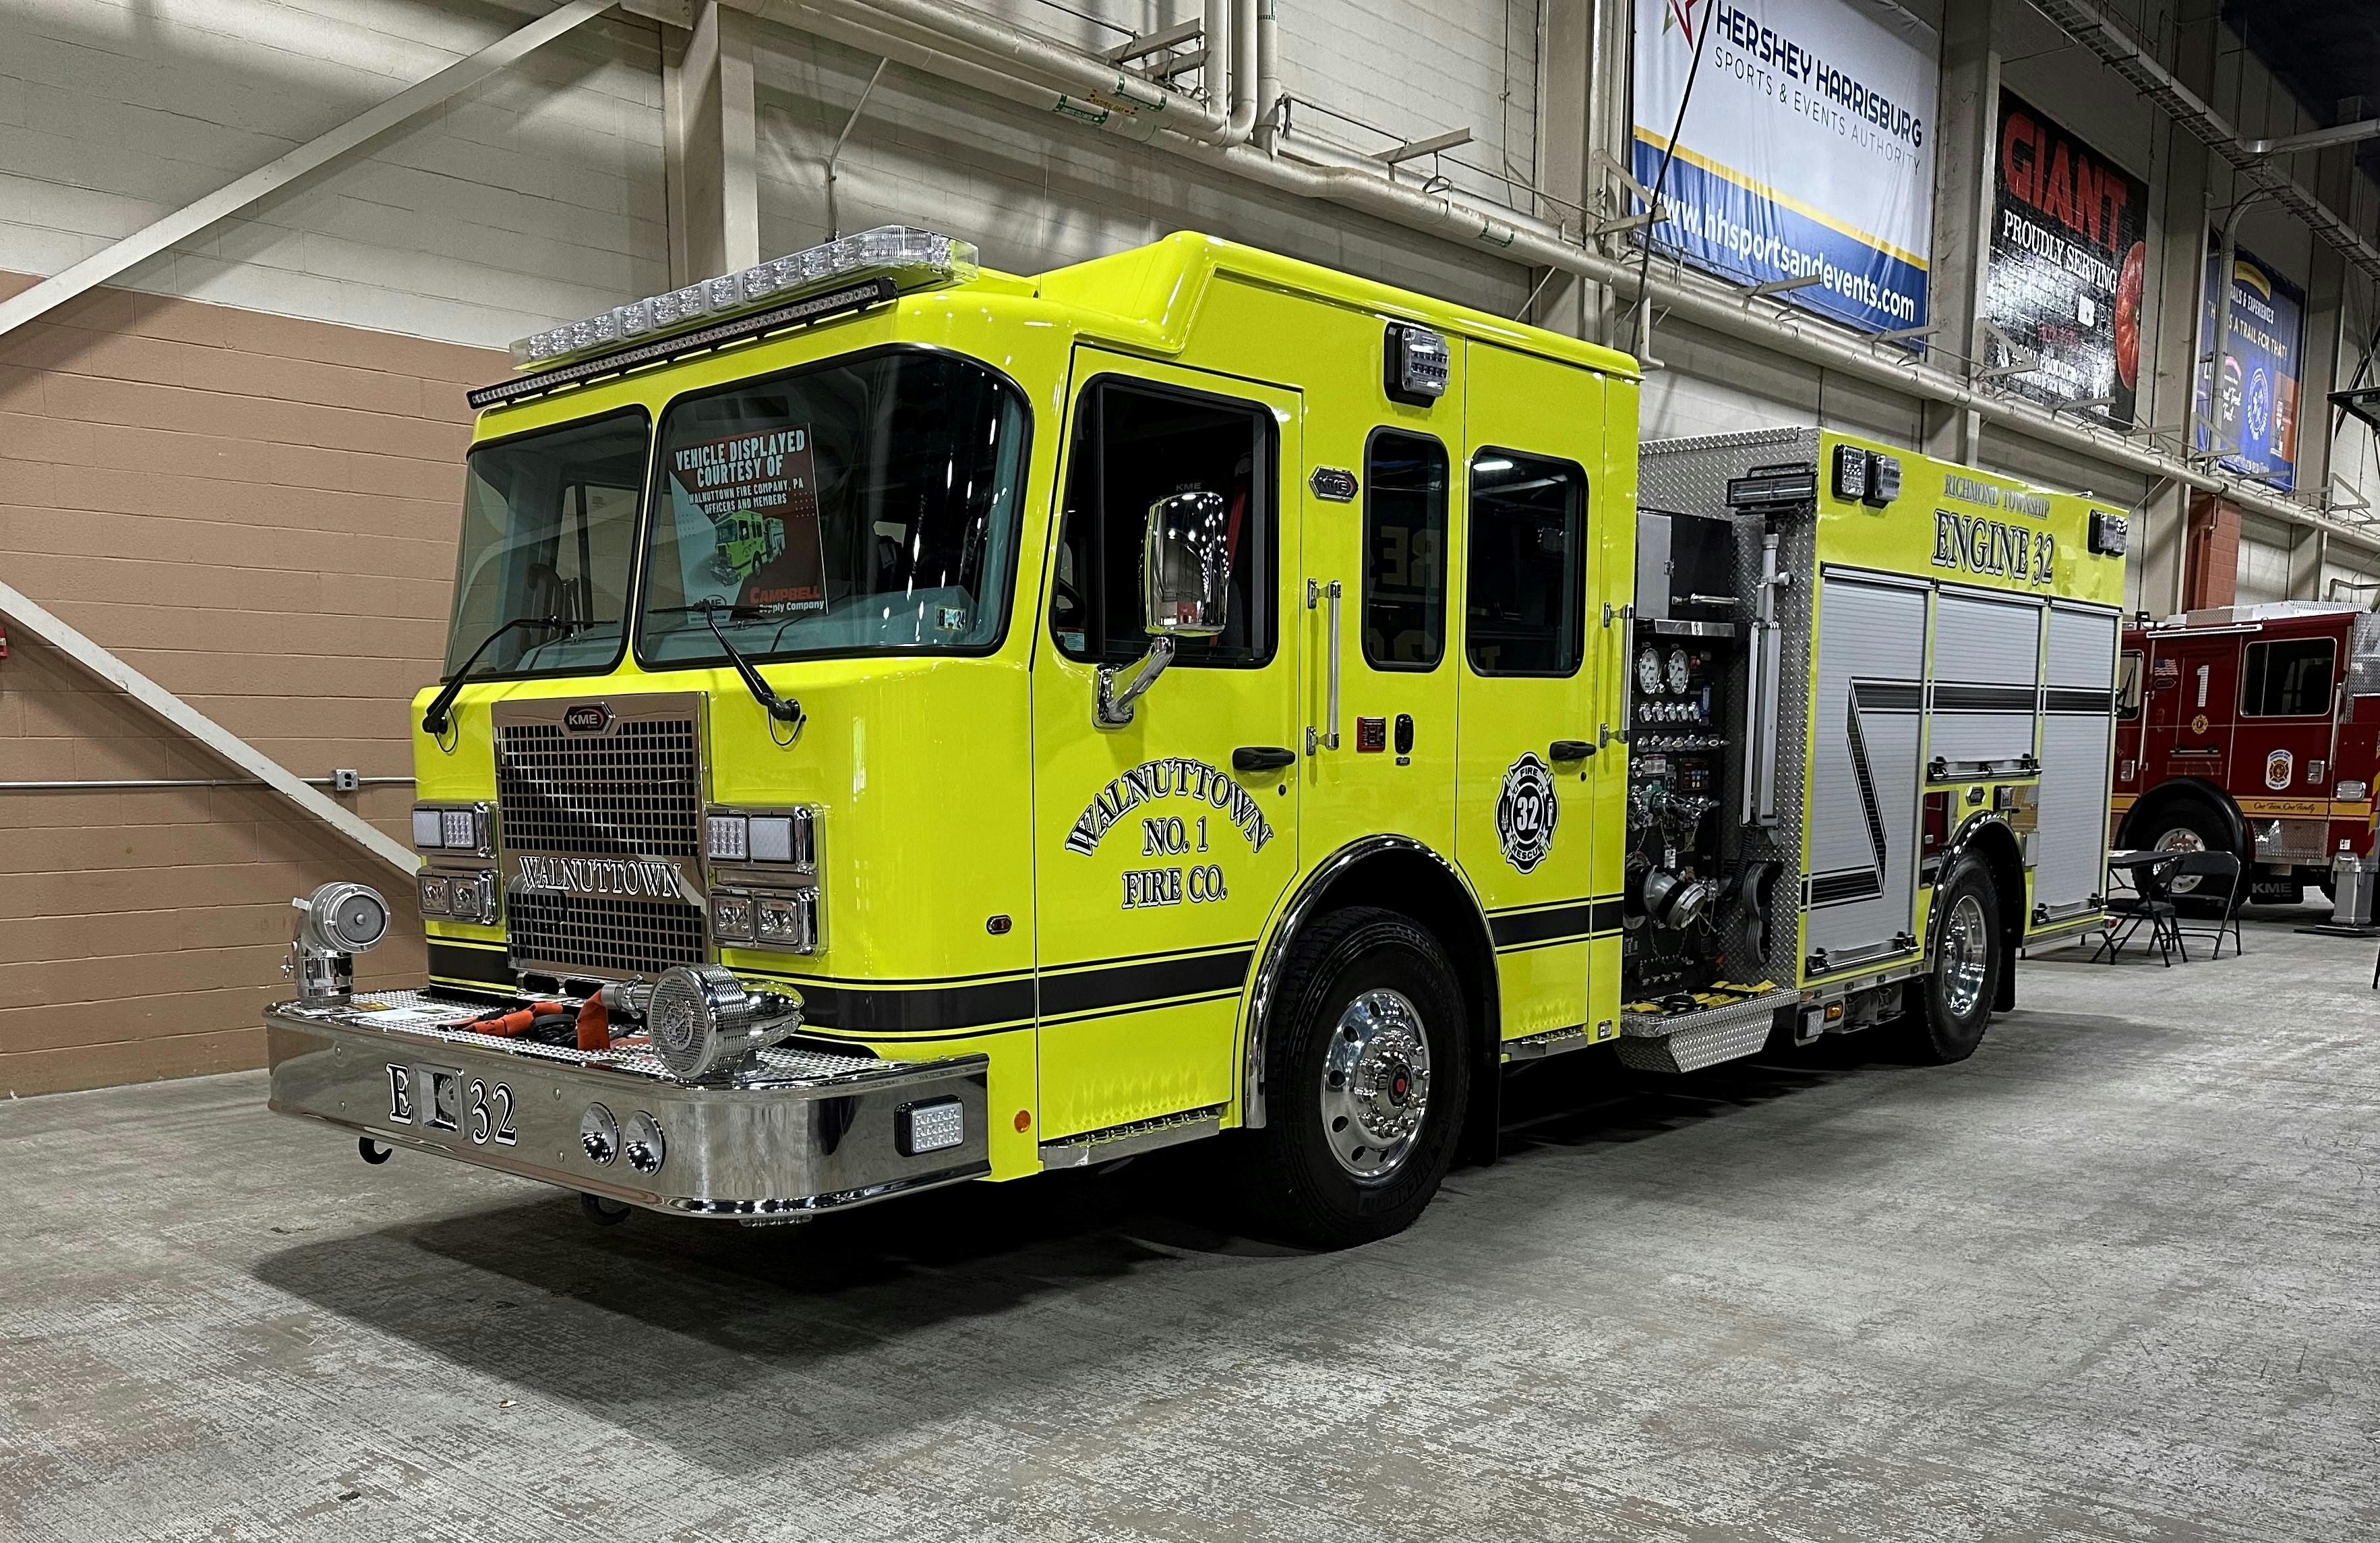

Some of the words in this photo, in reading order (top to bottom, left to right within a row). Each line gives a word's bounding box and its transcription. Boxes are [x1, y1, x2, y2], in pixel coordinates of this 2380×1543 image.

[1717, 0, 1811, 84] HERSHEY
[1816, 60, 1922, 148] HARRISBURG
[1715, 46, 1773, 96] SPORTS
[1779, 83, 1787, 105] &
[1794, 91, 1846, 136] EVENTS
[1851, 123, 1920, 175] AUTHORITY
[2002, 111, 2126, 252] GIANT
[2002, 209, 2066, 268] PROUDLY
[2065, 244, 2118, 295] SERVING
[2230, 285, 2242, 305] AILS
[2240, 319, 2257, 345] TRAIL
[2257, 330, 2269, 351] FOR
[2271, 338, 2288, 361] THAT!
[676, 443, 725, 471] VEHICLE
[730, 430, 805, 463] DISPLAYED
[688, 488, 734, 505] WALNUTTOWN
[736, 485, 752, 498] FIRE
[754, 482, 791, 496] COMPANY,
[793, 477, 804, 490] PA
[697, 458, 761, 488] COURTESY
[767, 455, 783, 477] OF
[1176, 482, 1201, 492] KME
[705, 501, 736, 515] OFFICERS
[738, 499, 751, 511] AND
[753, 494, 787, 508] MEMBERS
[1944, 474, 1998, 507] RICHMOND
[2002, 490, 2050, 520] TOWNSHIP
[1931, 508, 2029, 580] ENGINE
[2031, 532, 2054, 586] 32
[786, 600, 825, 612] Company
[2197, 665, 2209, 707] 1
[569, 714, 597, 726] KME
[1520, 766, 1538, 778] FIRE
[1065, 757, 1274, 856] WALNUTTOWN
[1517, 796, 1539, 831] 32
[1142, 817, 1189, 856] NO.
[1197, 816, 1209, 852] 1
[1511, 843, 1543, 861] RESCUE
[519, 855, 682, 900] WALNUTTOWN
[1122, 868, 1183, 909] FIRE
[1187, 864, 1228, 903] CO.
[2252, 883, 2292, 894] KME
[386, 1062, 413, 1126] E
[469, 1077, 518, 1147] 32
